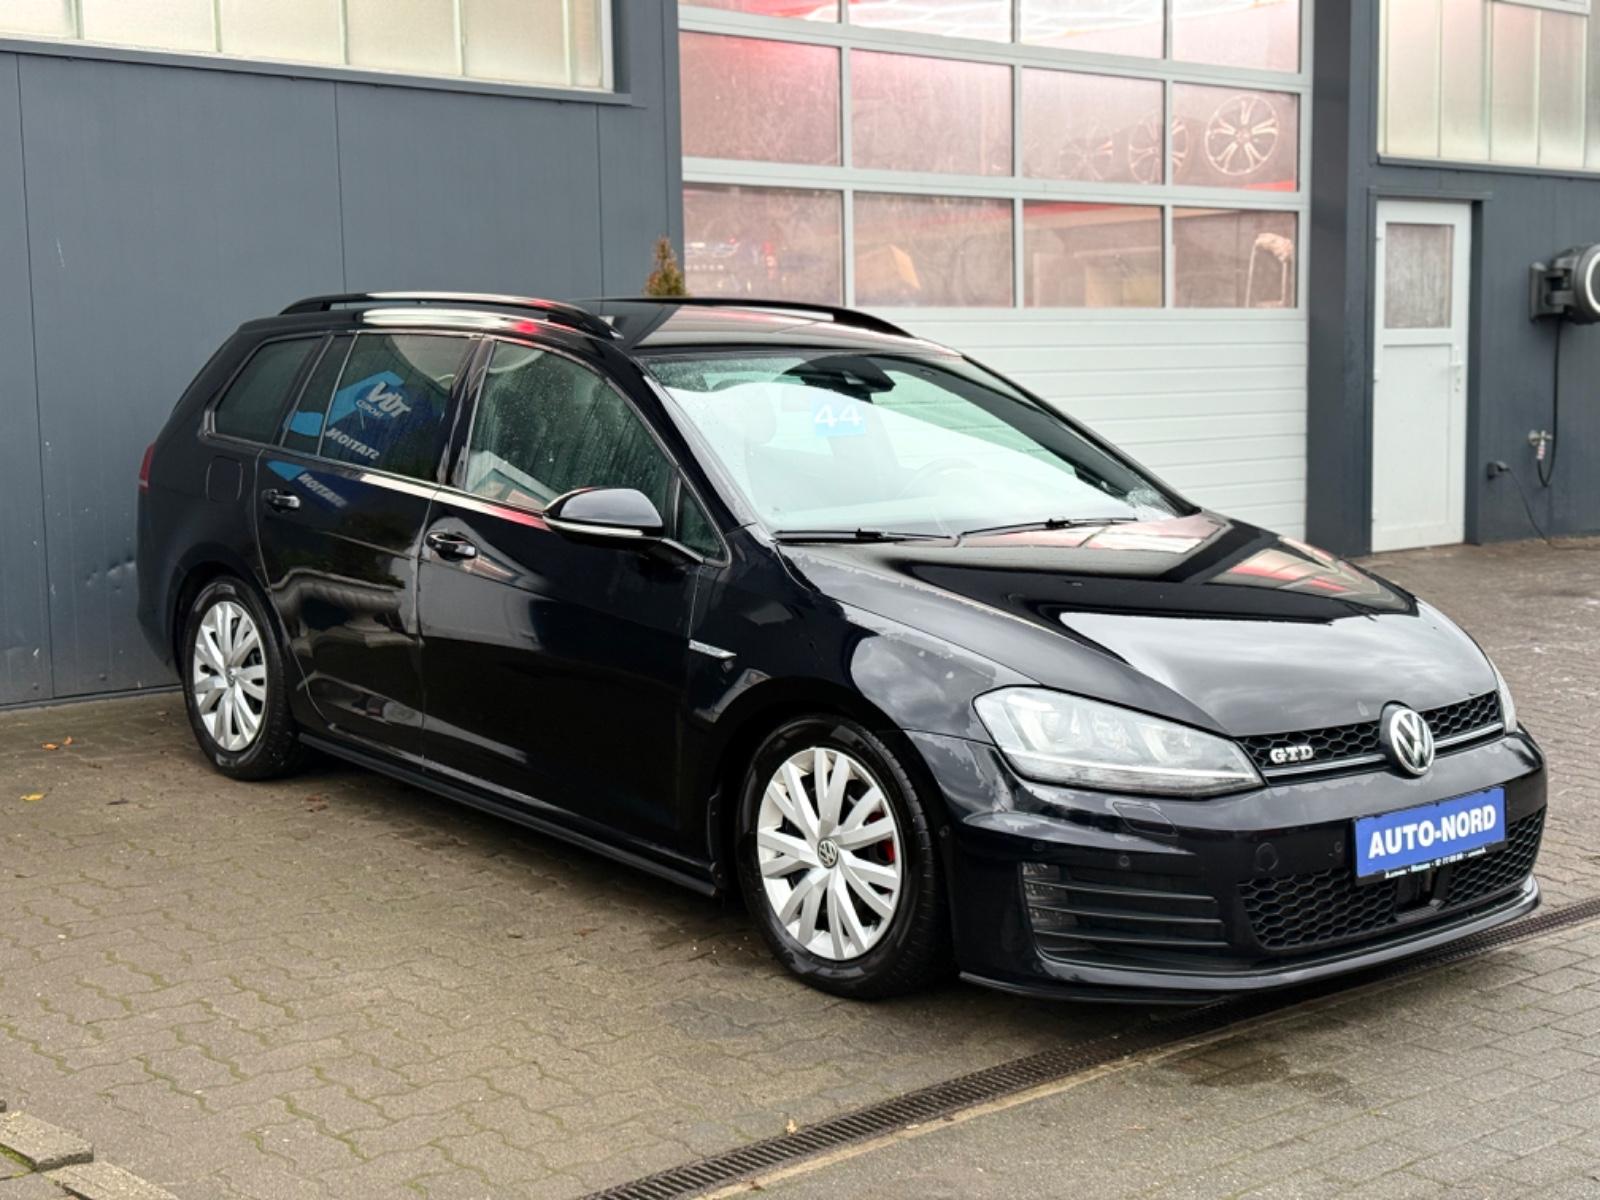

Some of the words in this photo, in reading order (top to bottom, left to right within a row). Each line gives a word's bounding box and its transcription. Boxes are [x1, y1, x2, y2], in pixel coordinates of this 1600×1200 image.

[814, 403, 863, 428] 44
[1269, 745, 1314, 764] GTD
[1368, 804, 1496, 860] AUTO-NORD
